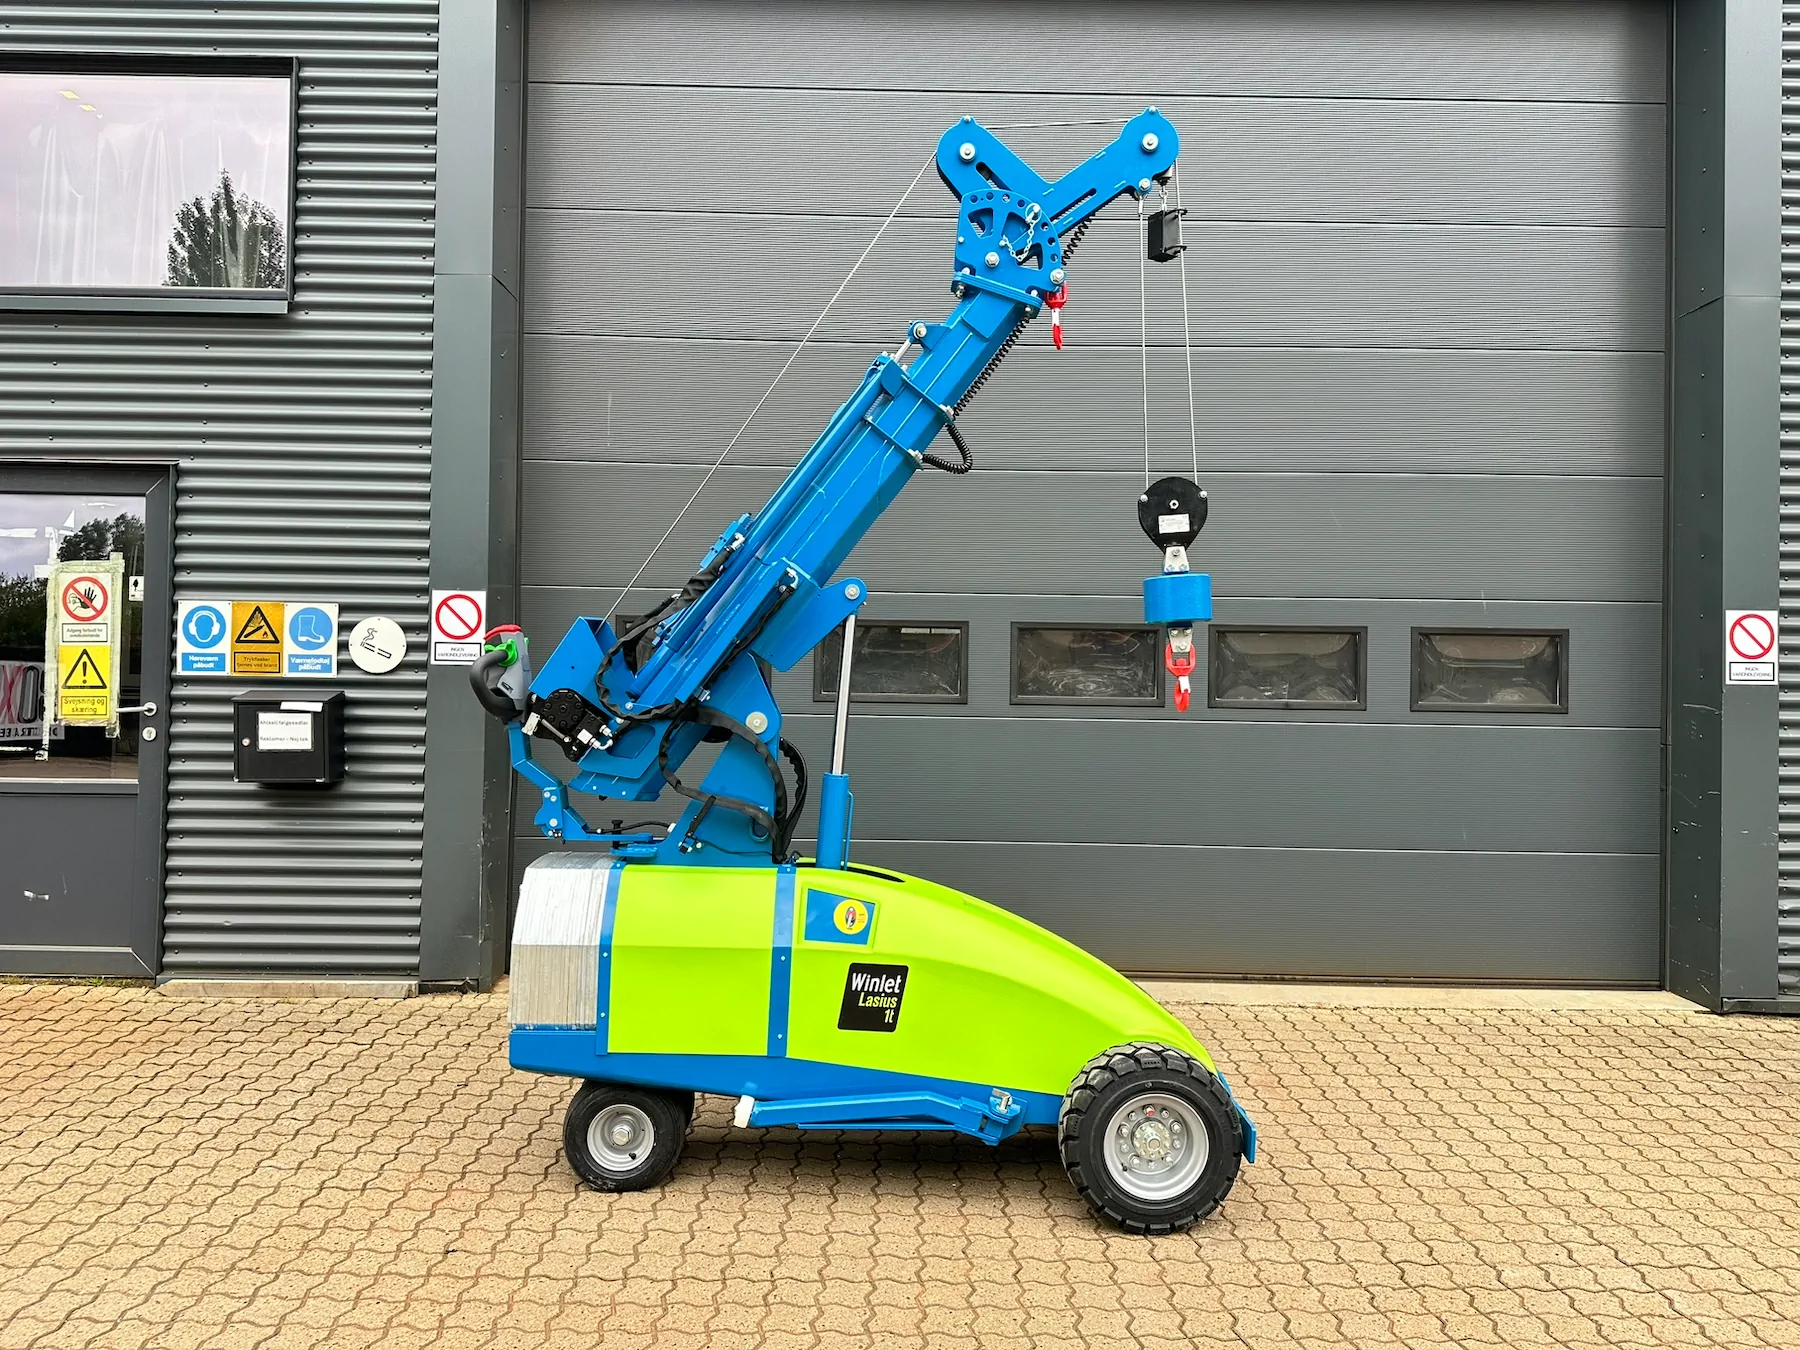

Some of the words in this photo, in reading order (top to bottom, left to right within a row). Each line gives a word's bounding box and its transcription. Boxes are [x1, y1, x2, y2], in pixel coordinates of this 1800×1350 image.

[192, 661, 215, 669] påbudt
[290, 656, 330, 665] Værnefodtøj
[298, 664, 322, 672] påbudt
[64, 698, 95, 706] Svejsning
[71, 706, 98, 715] skæring
[851, 972, 902, 993] Winlet
[858, 992, 898, 1008] Lasius
[884, 1009, 895, 1023] 1t
